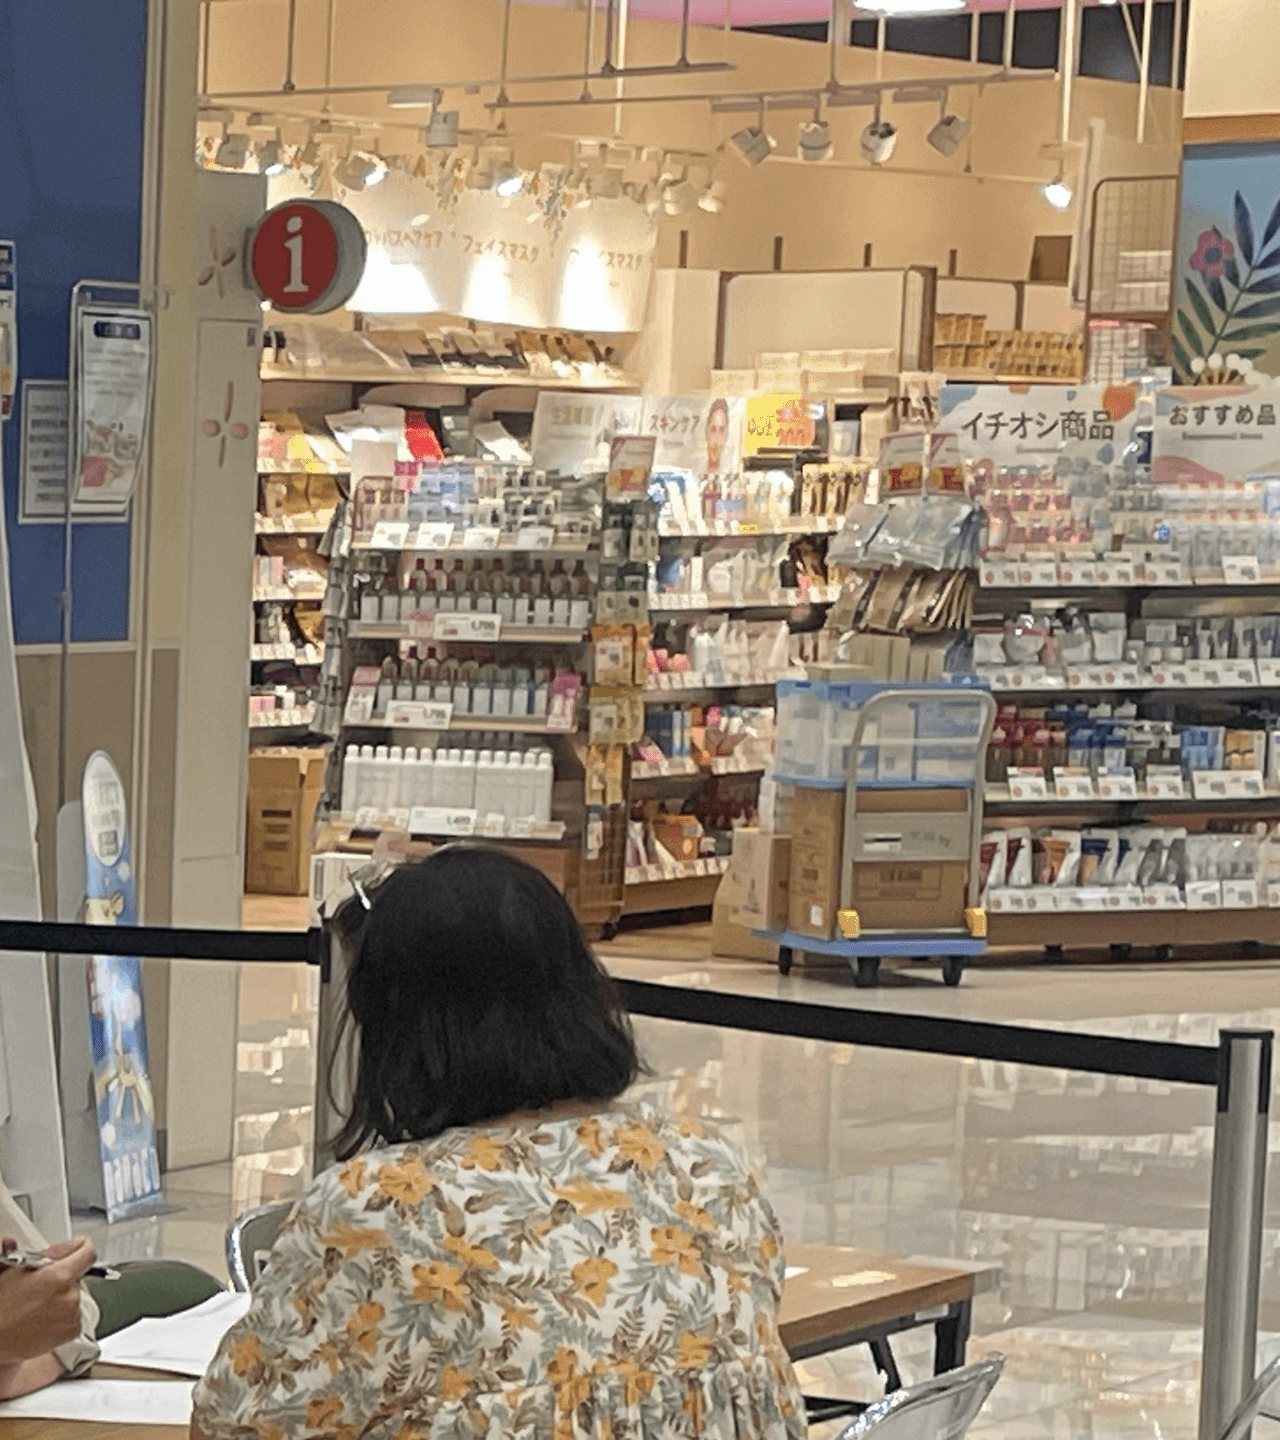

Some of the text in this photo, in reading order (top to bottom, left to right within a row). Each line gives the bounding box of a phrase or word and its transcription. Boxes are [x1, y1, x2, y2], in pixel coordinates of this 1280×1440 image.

[462, 234, 539, 262] フェイスマスク
[961, 409, 1115, 441] イチオシ商品
[1168, 404, 1277, 427] おすすめ品
